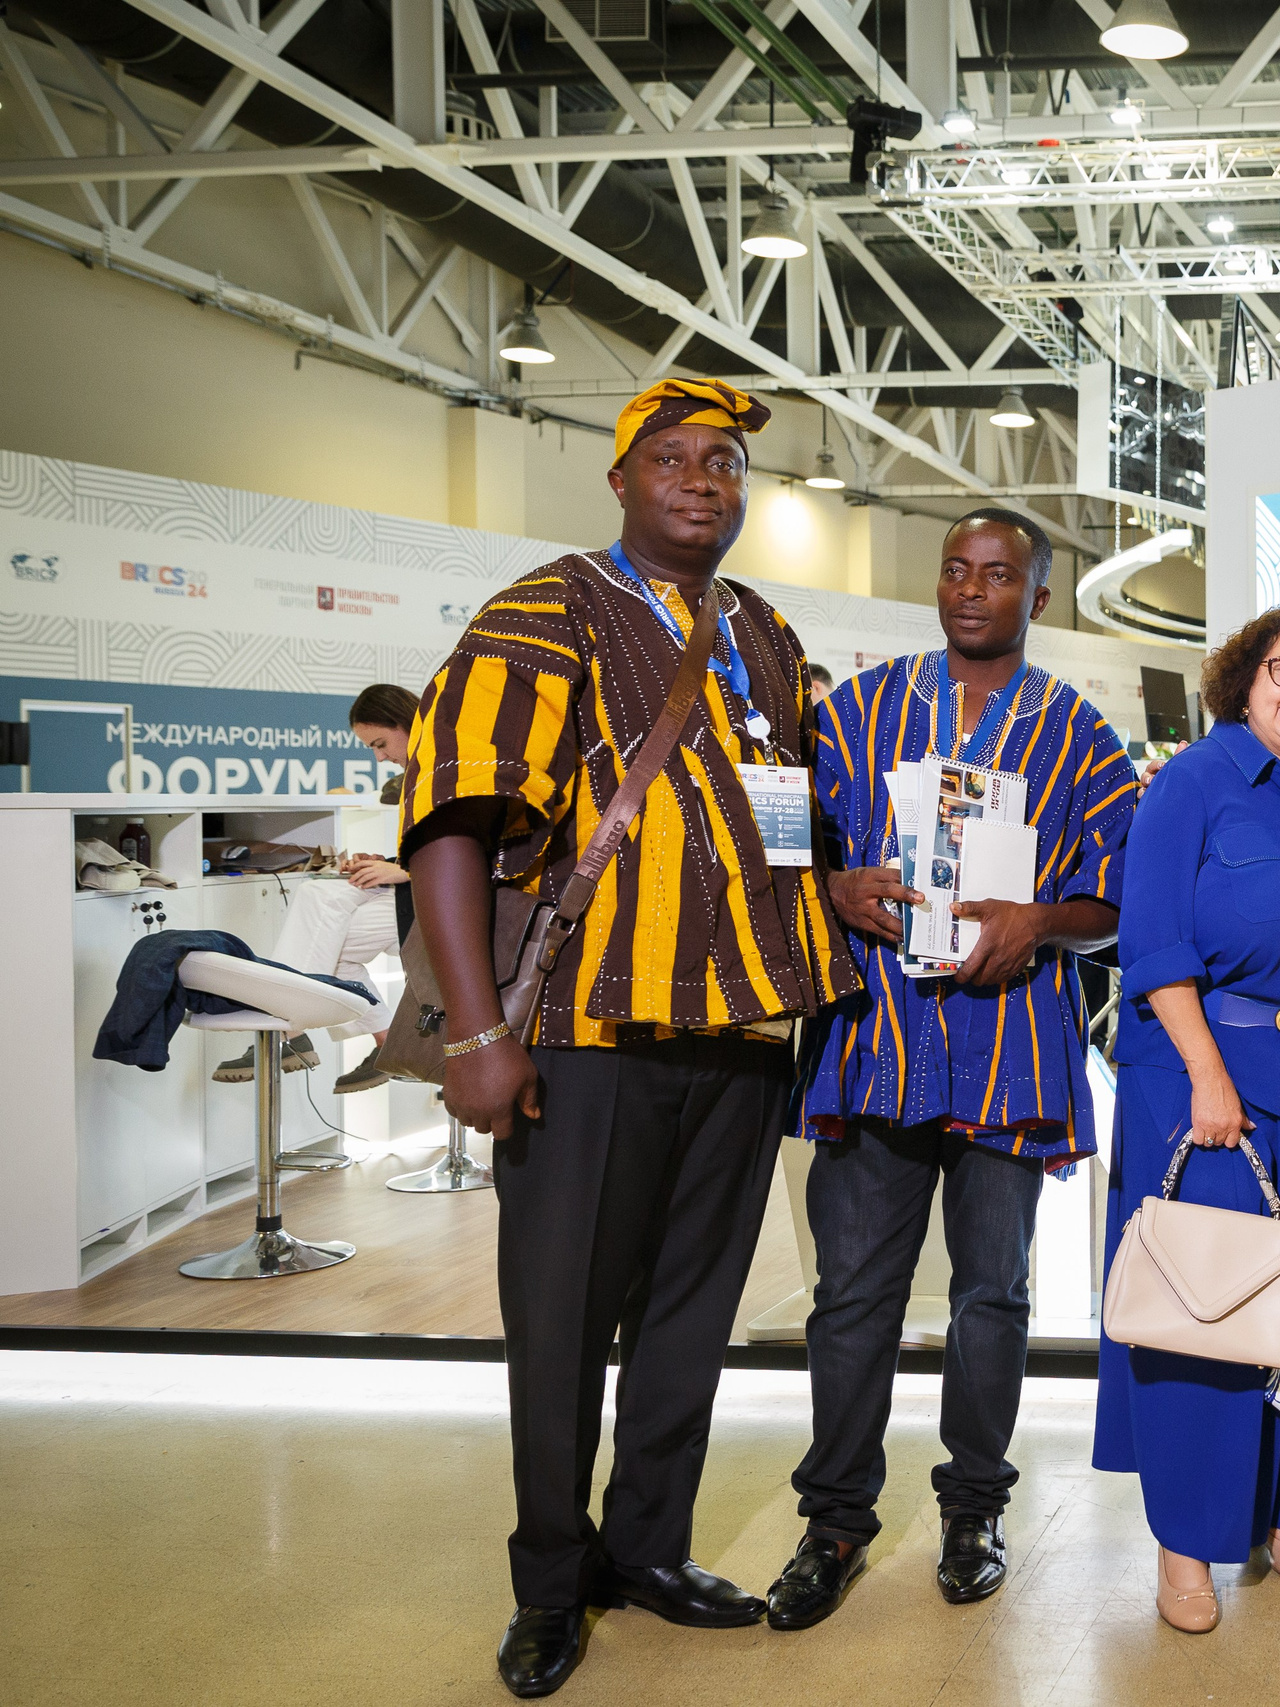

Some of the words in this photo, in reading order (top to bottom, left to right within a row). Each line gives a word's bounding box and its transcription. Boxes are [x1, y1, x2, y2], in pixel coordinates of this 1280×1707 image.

[187, 583, 208, 598] 24
[654, 604, 678, 632] IMBRICS
[106, 722, 322, 749] МЕЖДУНАРОДНЫЙ
[107, 755, 328, 795] ФОРУМ
[769, 797, 804, 807] FORUM
[773, 806, 794, 814] 27-28
